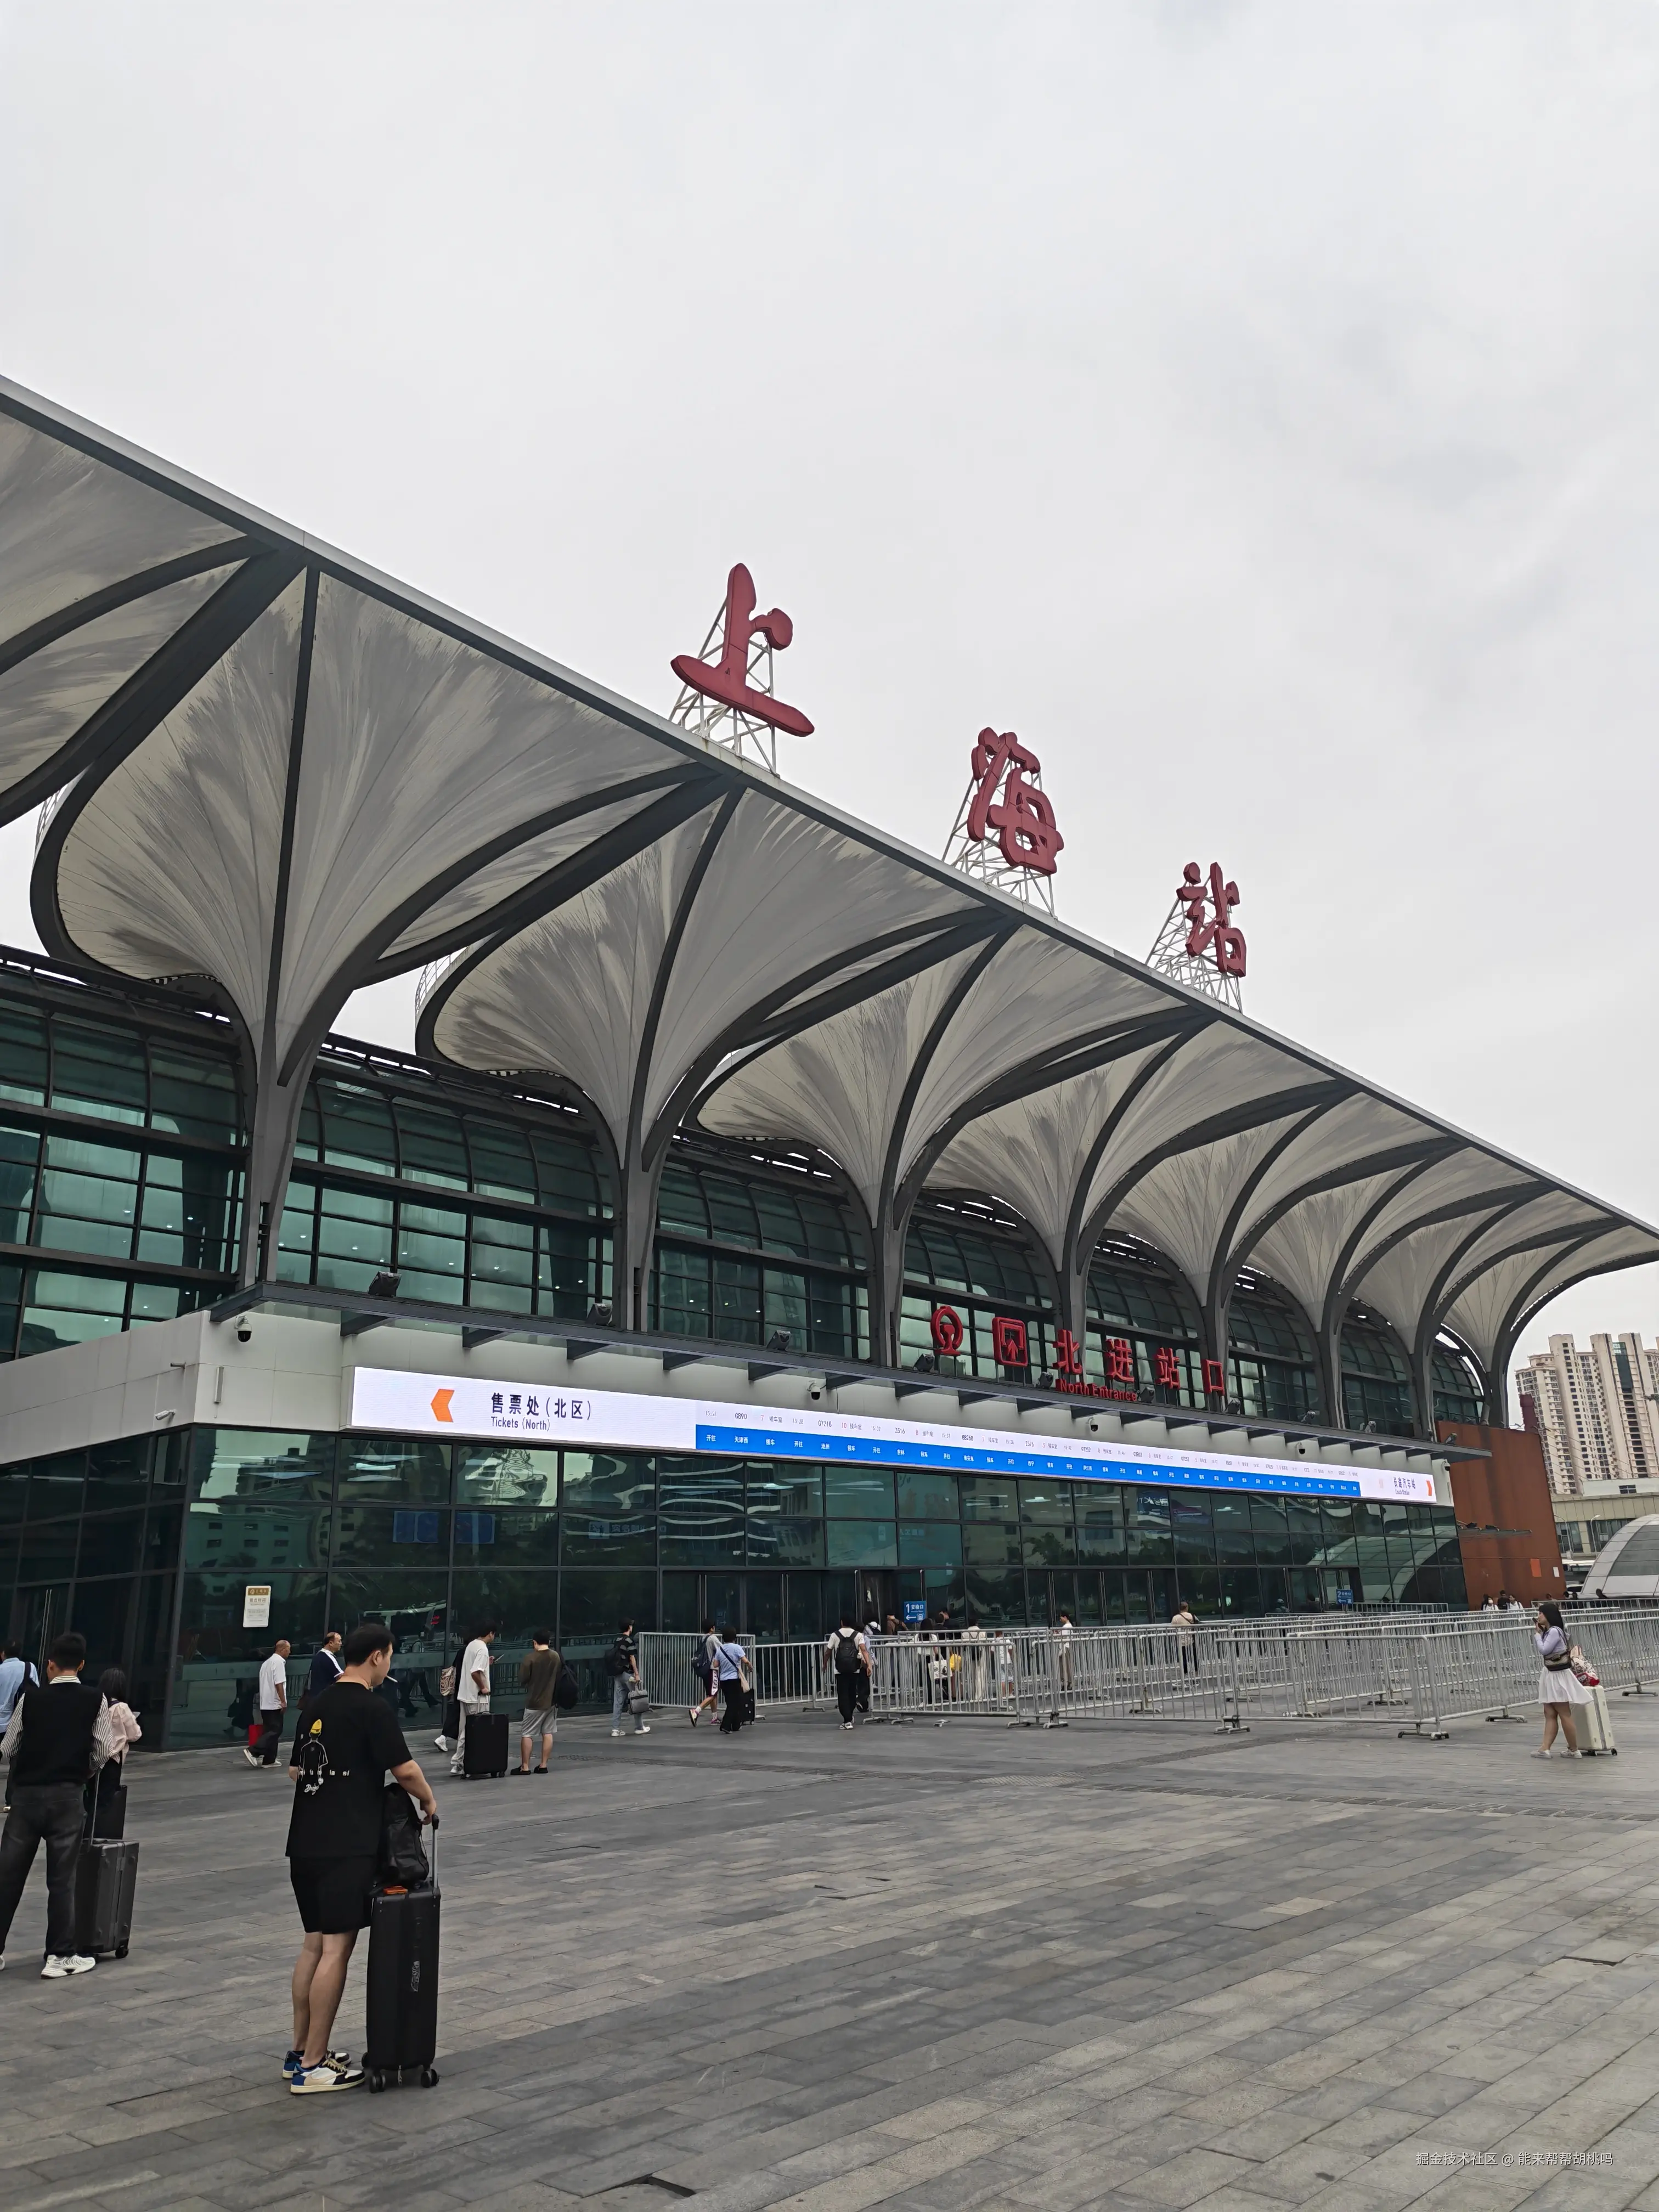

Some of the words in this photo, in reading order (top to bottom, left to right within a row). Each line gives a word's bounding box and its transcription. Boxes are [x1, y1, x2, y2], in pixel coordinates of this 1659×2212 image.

[670, 563, 1246, 977] 上海站
[1052, 1329, 1224, 1396] 北进站口
[1057, 1379, 1090, 1396] North
[1090, 1383, 1138, 1401] Entrance
[491, 1392, 592, 1420] 售票处（北区）
[491, 1416, 518, 1429] Tickets
[522, 1417, 550, 1431] (North)
[1393, 1476, 1415, 1489] 长途汽车站
[906, 1603, 910, 1613] 1
